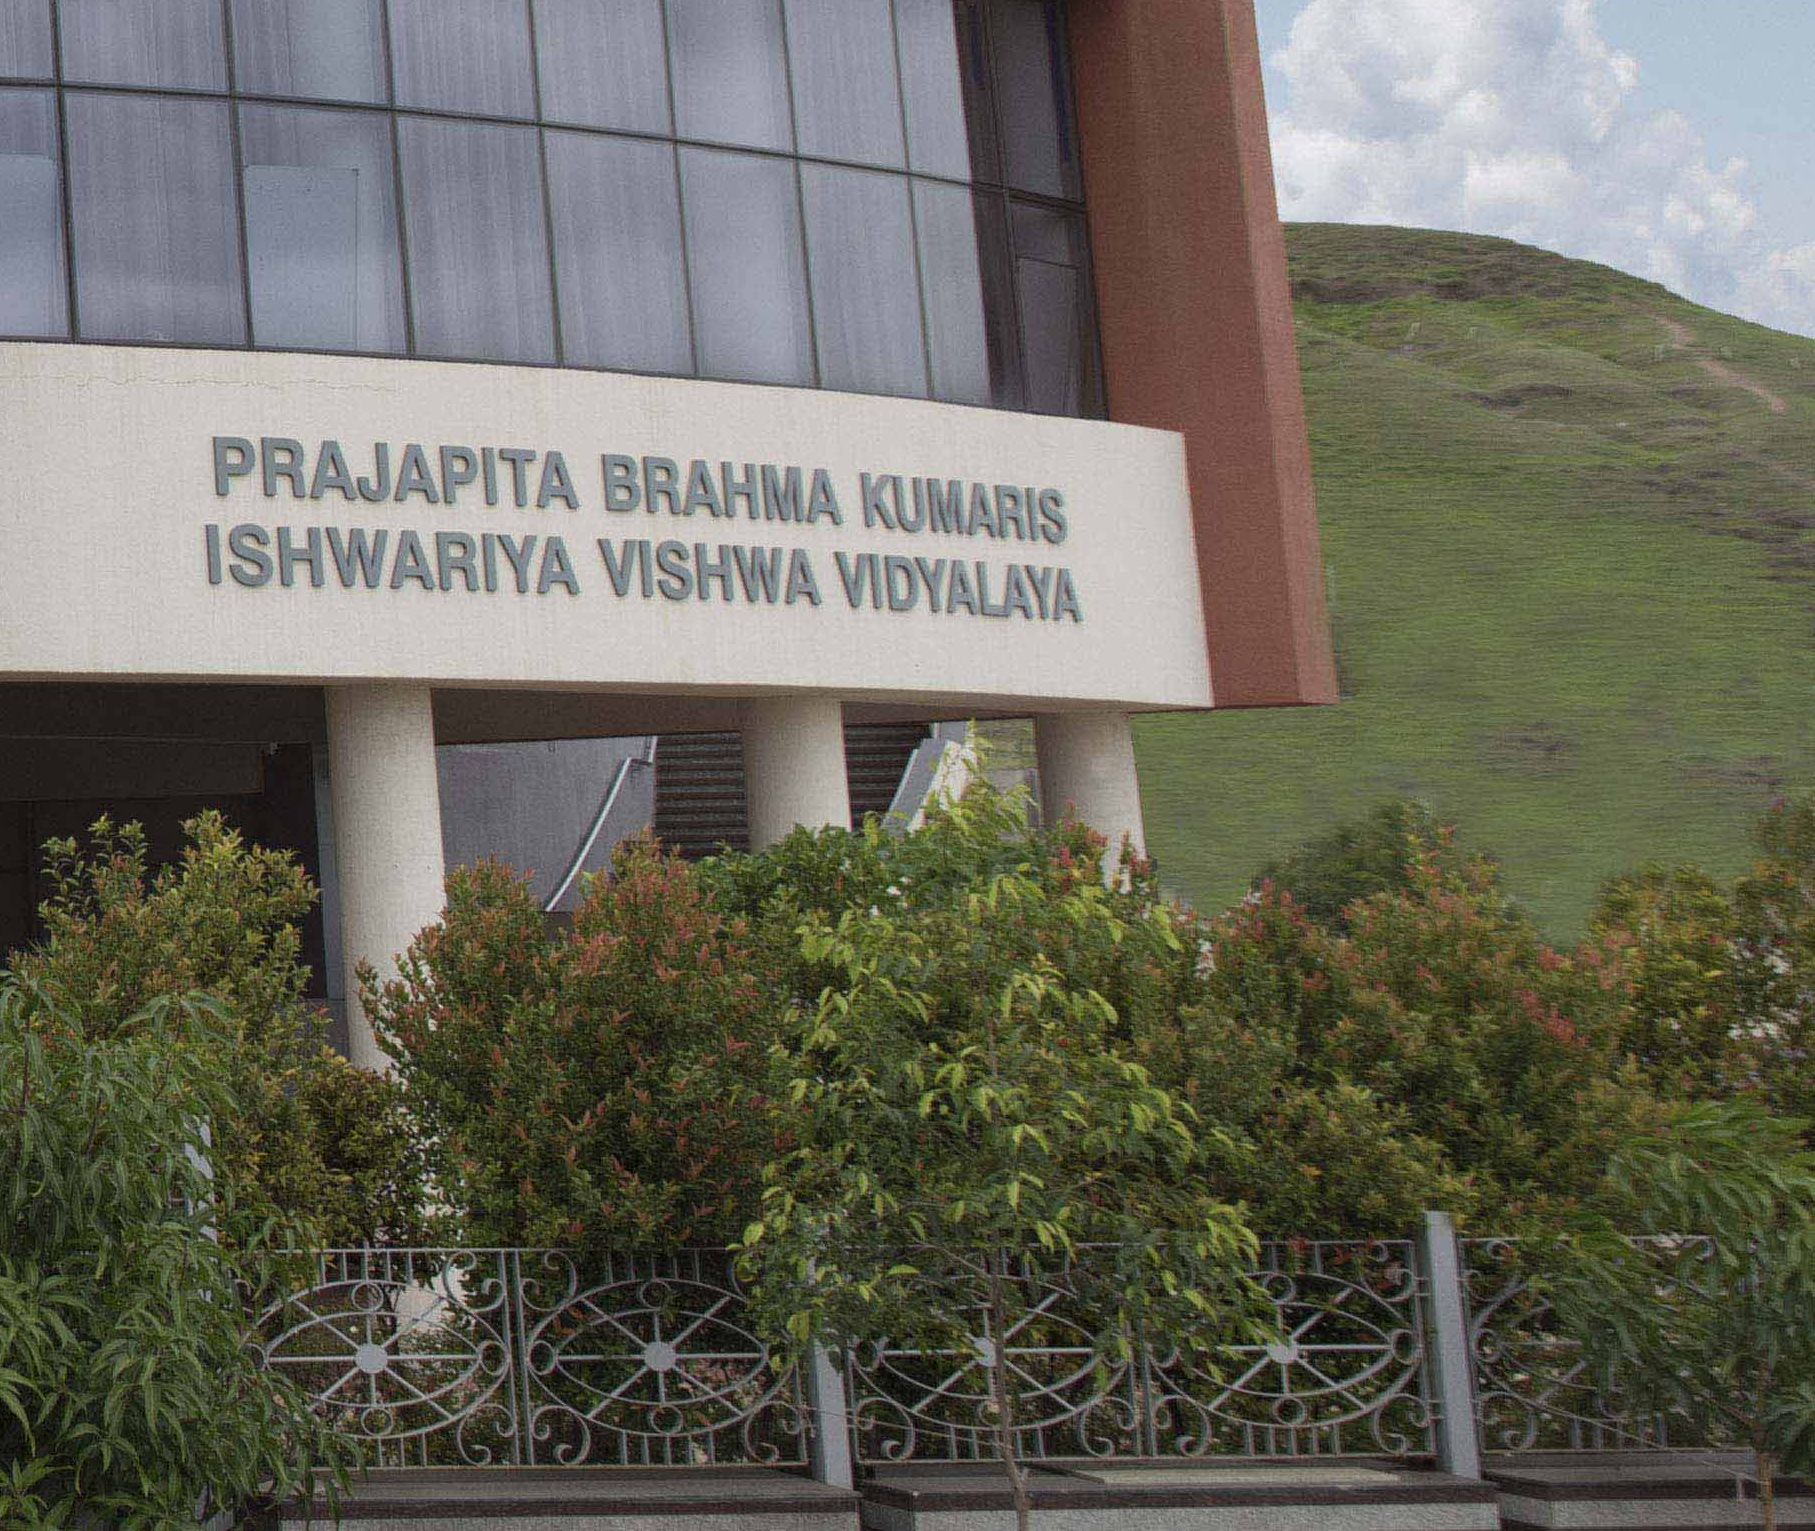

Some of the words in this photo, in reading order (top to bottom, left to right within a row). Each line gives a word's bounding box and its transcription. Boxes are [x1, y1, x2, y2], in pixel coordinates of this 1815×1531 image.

[211, 436, 580, 511] PRAJAPITA
[600, 453, 844, 527] BRAHMA
[859, 472, 1068, 546] KUMARIS
[204, 523, 581, 598] ISHWARIYA
[596, 538, 823, 607] VISHWA
[832, 551, 1085, 624] VIDYALAYA
